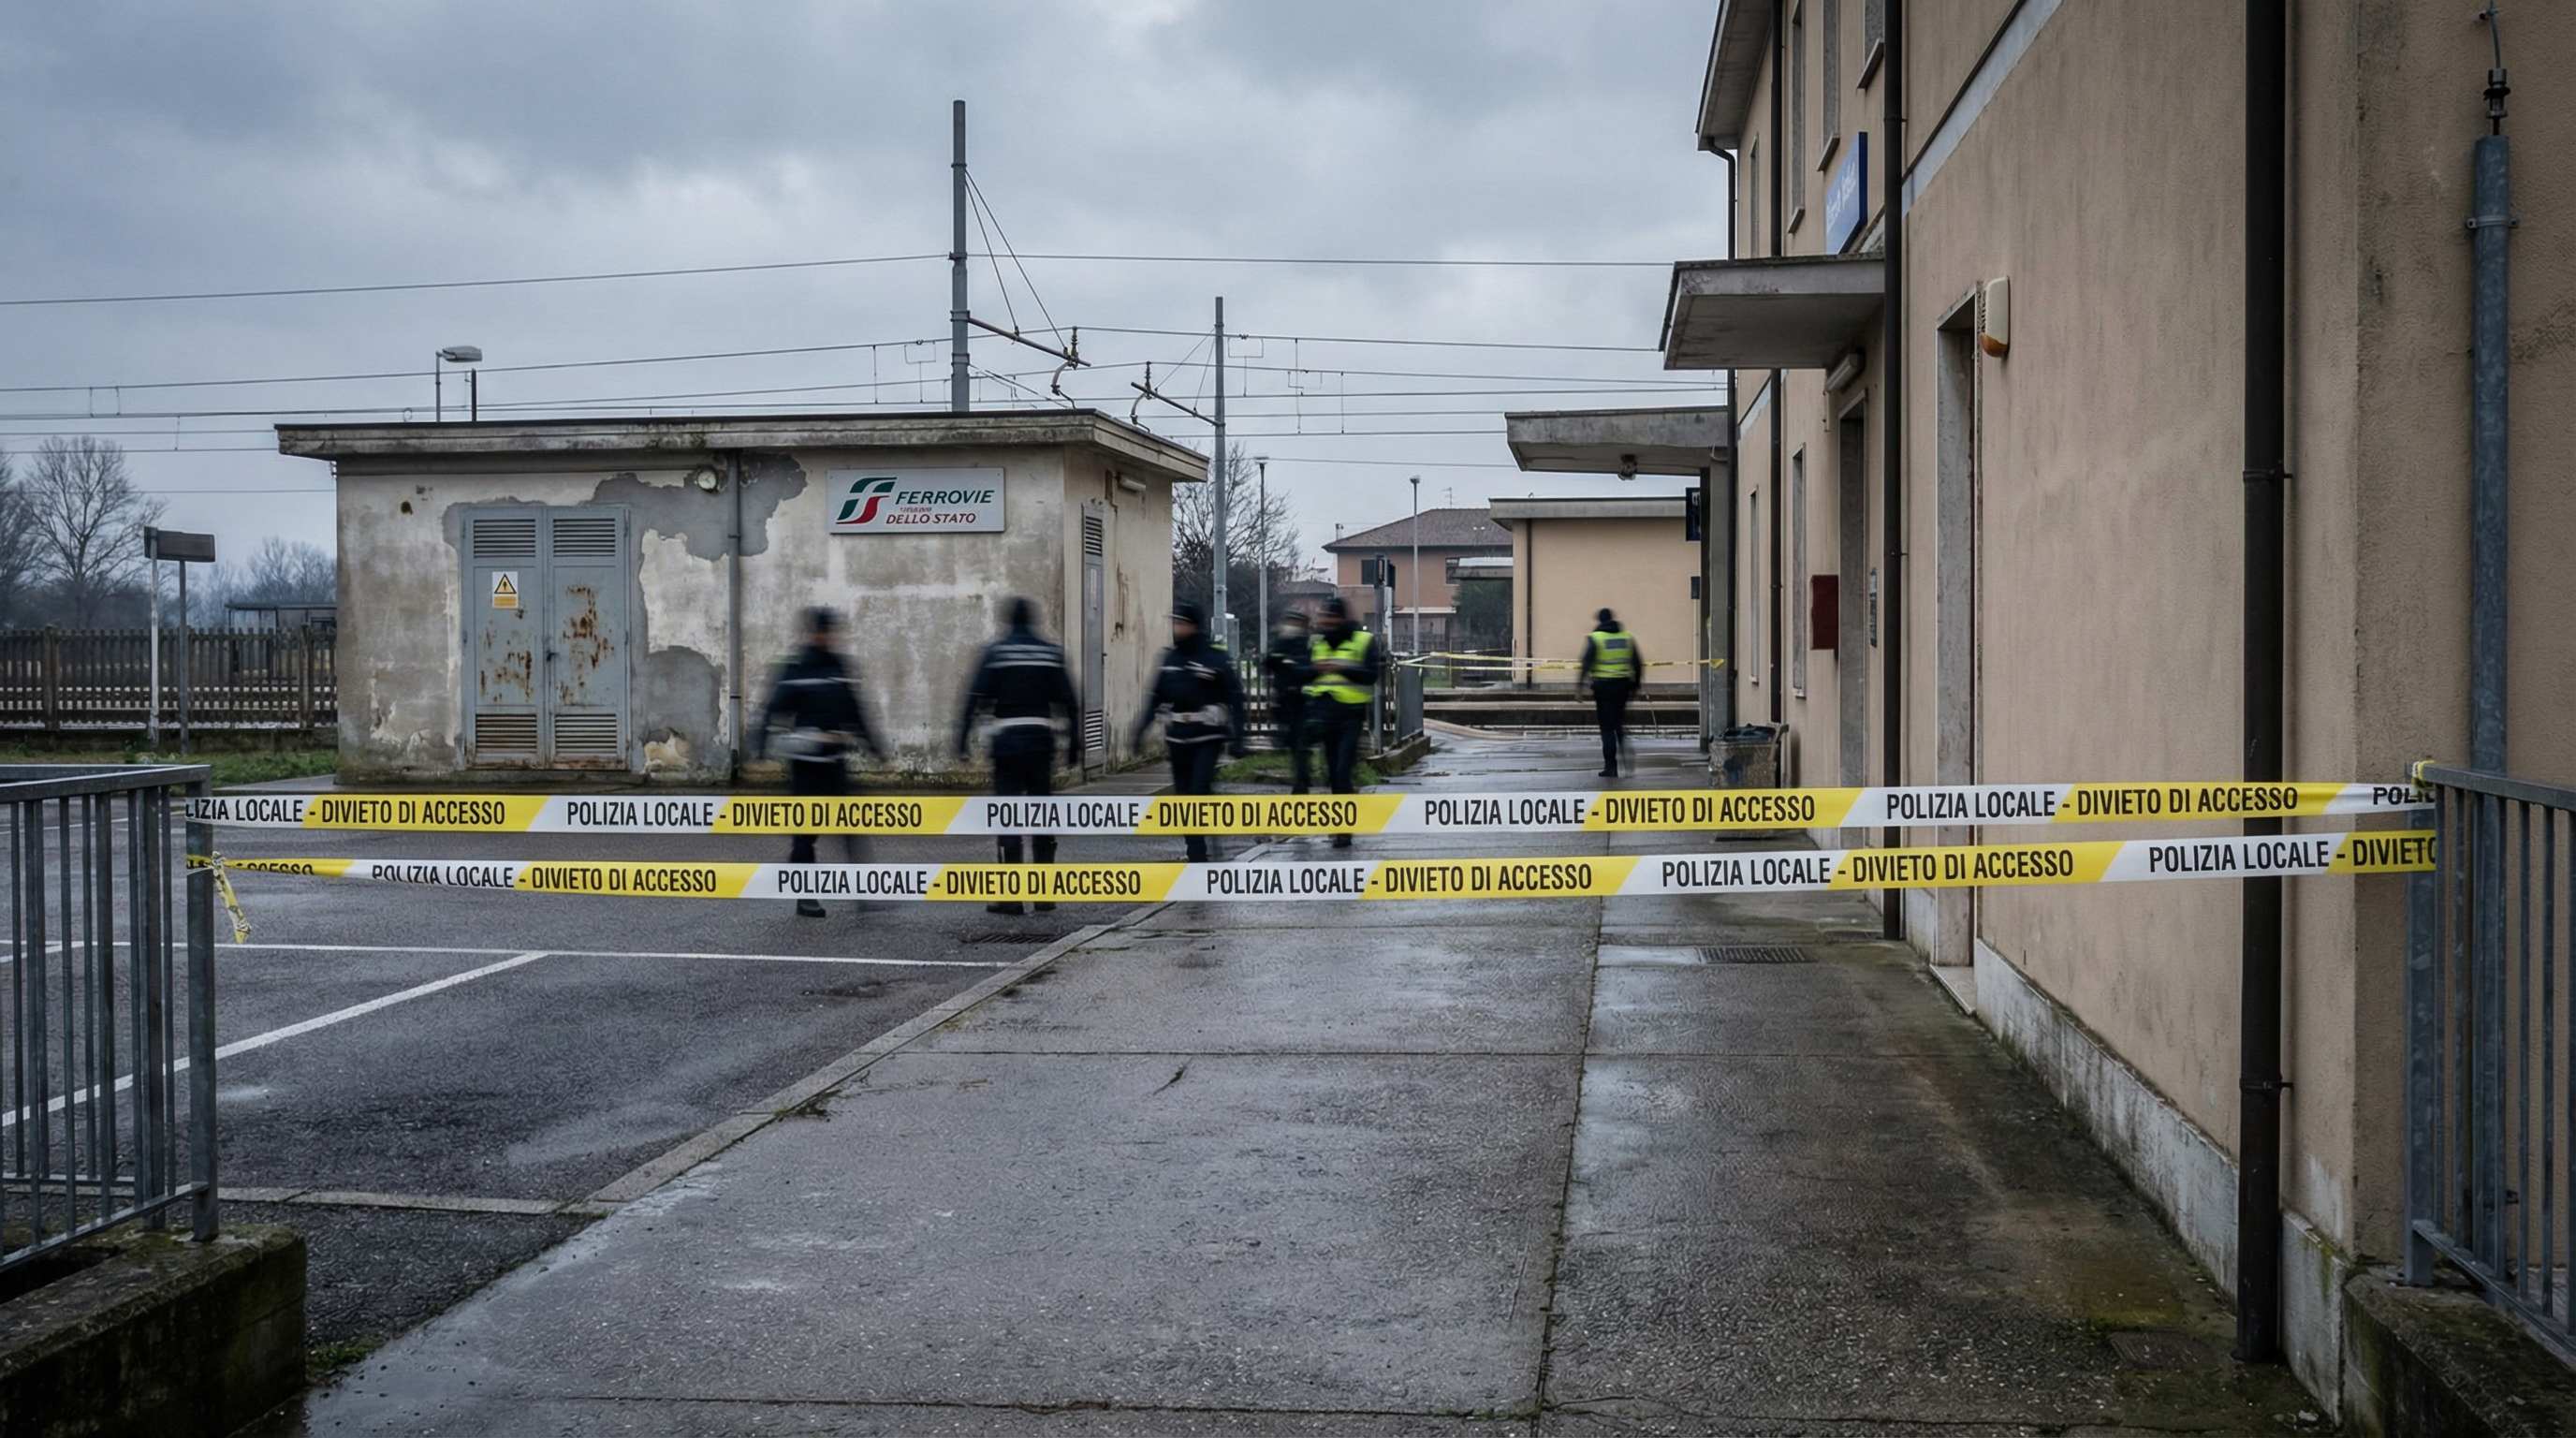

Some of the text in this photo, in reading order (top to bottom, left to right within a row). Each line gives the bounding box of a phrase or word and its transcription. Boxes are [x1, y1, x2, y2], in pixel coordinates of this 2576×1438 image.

[895, 490, 994, 505] FERROVIE
[886, 512, 976, 524] DELLO STATO
[236, 800, 302, 822] LOCALE
[323, 800, 391, 823] DIVIETO
[399, 801, 415, 823] DI
[422, 801, 505, 824] ACCESSO
[568, 801, 637, 825] POLIZIA
[644, 802, 713, 826] LOCALE
[733, 803, 804, 827] DIVIETO
[812, 803, 828, 827] DI
[836, 803, 921, 827] ACCESSO
[988, 803, 1060, 828] POLIZIA
[1067, 803, 1138, 828] LOCALE
[1160, 802, 1234, 827] DIVIETO
[1242, 802, 1260, 827] DI
[1267, 801, 1356, 827] ACCESSO
[1426, 800, 1501, 825] POLIZIA
[1509, 800, 1584, 825] LOCALE
[1606, 798, 1685, 823] DIVIETO
[1693, 798, 1712, 822] DI
[1720, 796, 1814, 822] ACCESSO
[1887, 793, 1968, 819] POLIZIA
[1976, 791, 2055, 817] LOCALE
[2078, 789, 2160, 815] DIVIETO
[2170, 789, 2189, 813] DI
[2198, 787, 2297, 812] ACCESSO
[372, 865, 442, 885] POLIZIA
[446, 866, 514, 888] LOCALE
[533, 868, 602, 890] DIVIETO
[609, 869, 626, 890] DI
[634, 870, 716, 892] ACCESSO
[779, 871, 850, 893] POLIZIA
[856, 871, 927, 894] LOCALE
[947, 871, 1019, 894] DIVIETO
[1028, 872, 1046, 894] DI
[1053, 871, 1140, 895] ACCESSO
[1208, 870, 1282, 894] POLIZIA
[1290, 869, 1364, 893] LOCALE
[1386, 867, 1463, 892] DIVIETO
[1471, 866, 1490, 890] DI
[1499, 864, 1591, 890] ACCESSO
[1662, 860, 1743, 887] POLIZIA
[1751, 858, 1831, 885] LOCALE
[1853, 855, 1936, 882] DIVIETO
[1945, 854, 1965, 879] DI
[1974, 850, 2072, 878] ACCESSO
[2150, 844, 2236, 873] POLIZIA
[2244, 842, 2329, 869] LOCALE
